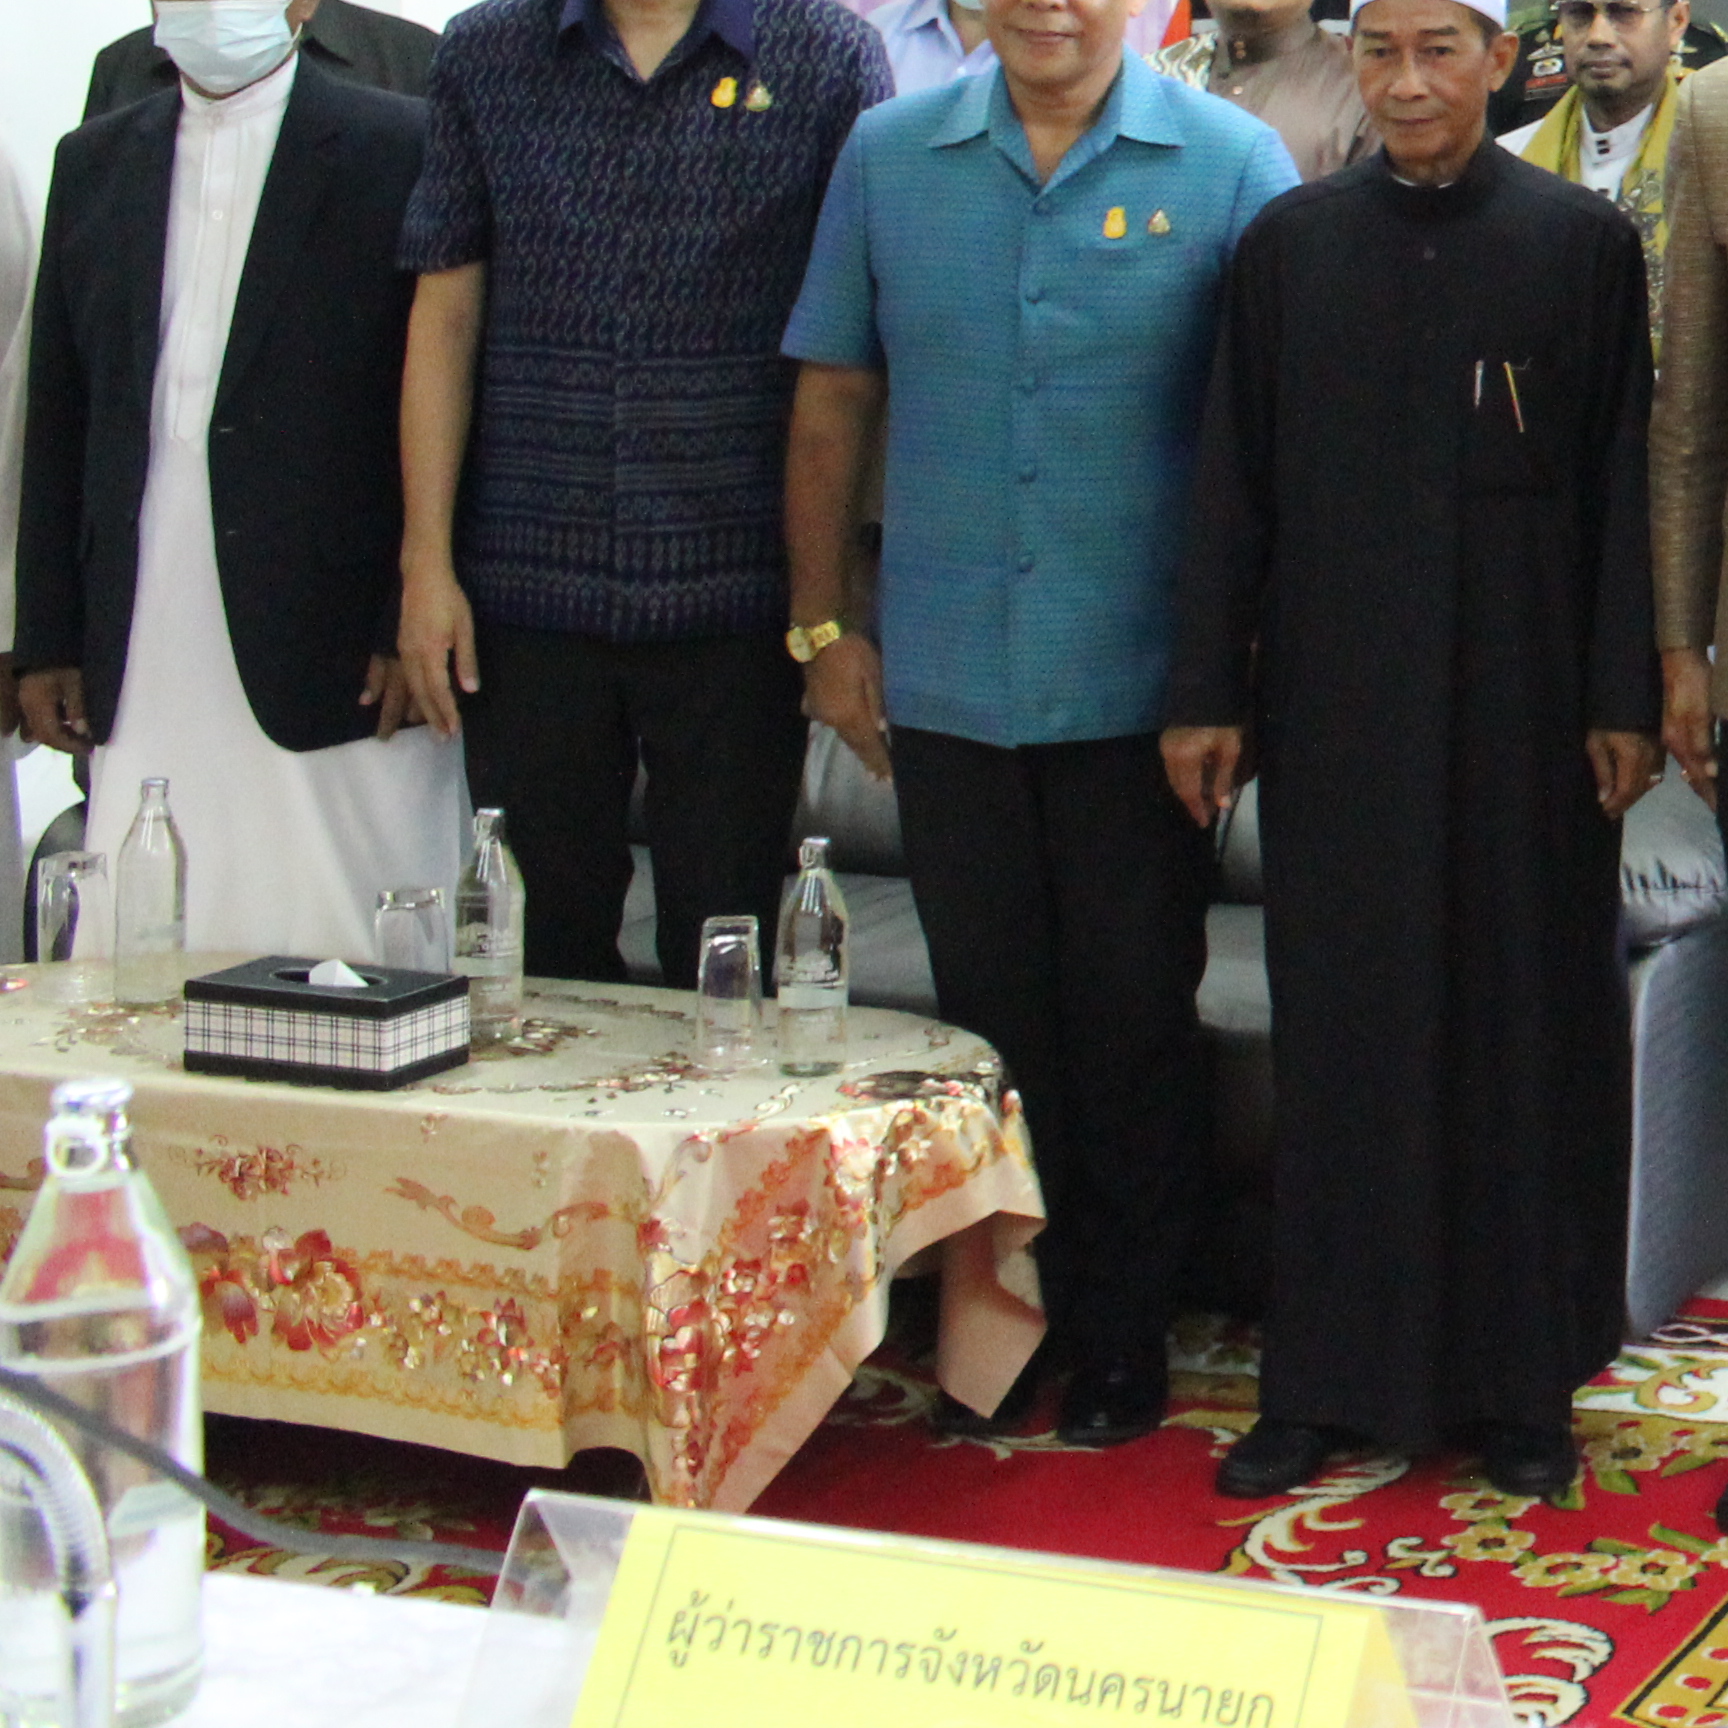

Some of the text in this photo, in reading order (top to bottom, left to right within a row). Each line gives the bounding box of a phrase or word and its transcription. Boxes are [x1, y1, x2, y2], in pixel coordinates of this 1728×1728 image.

[665, 1590, 1276, 1728] ผู้ว่าราชการจังหวัดนครนายก
